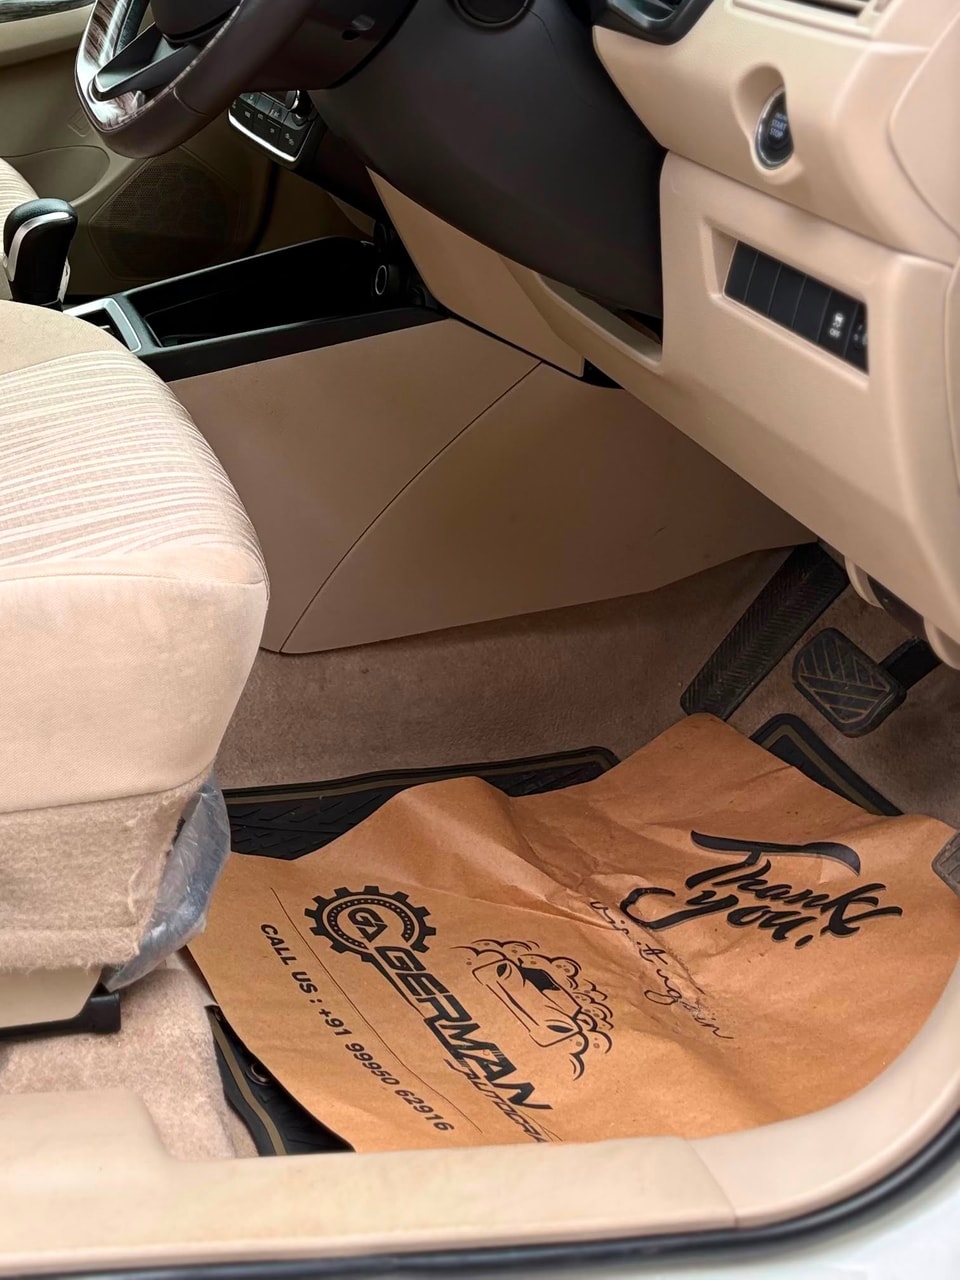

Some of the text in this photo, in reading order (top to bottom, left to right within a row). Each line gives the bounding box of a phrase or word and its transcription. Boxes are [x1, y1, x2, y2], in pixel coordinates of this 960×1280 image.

[685, 829, 903, 938] Thank
[260, 923, 297, 966] CALL
[291, 971, 319, 994] US
[318, 1008, 353, 1036] +91
[344, 1042, 401, 1086] 99950
[395, 1089, 455, 1132] 62916
[374, 945, 554, 1110] GERMAN
